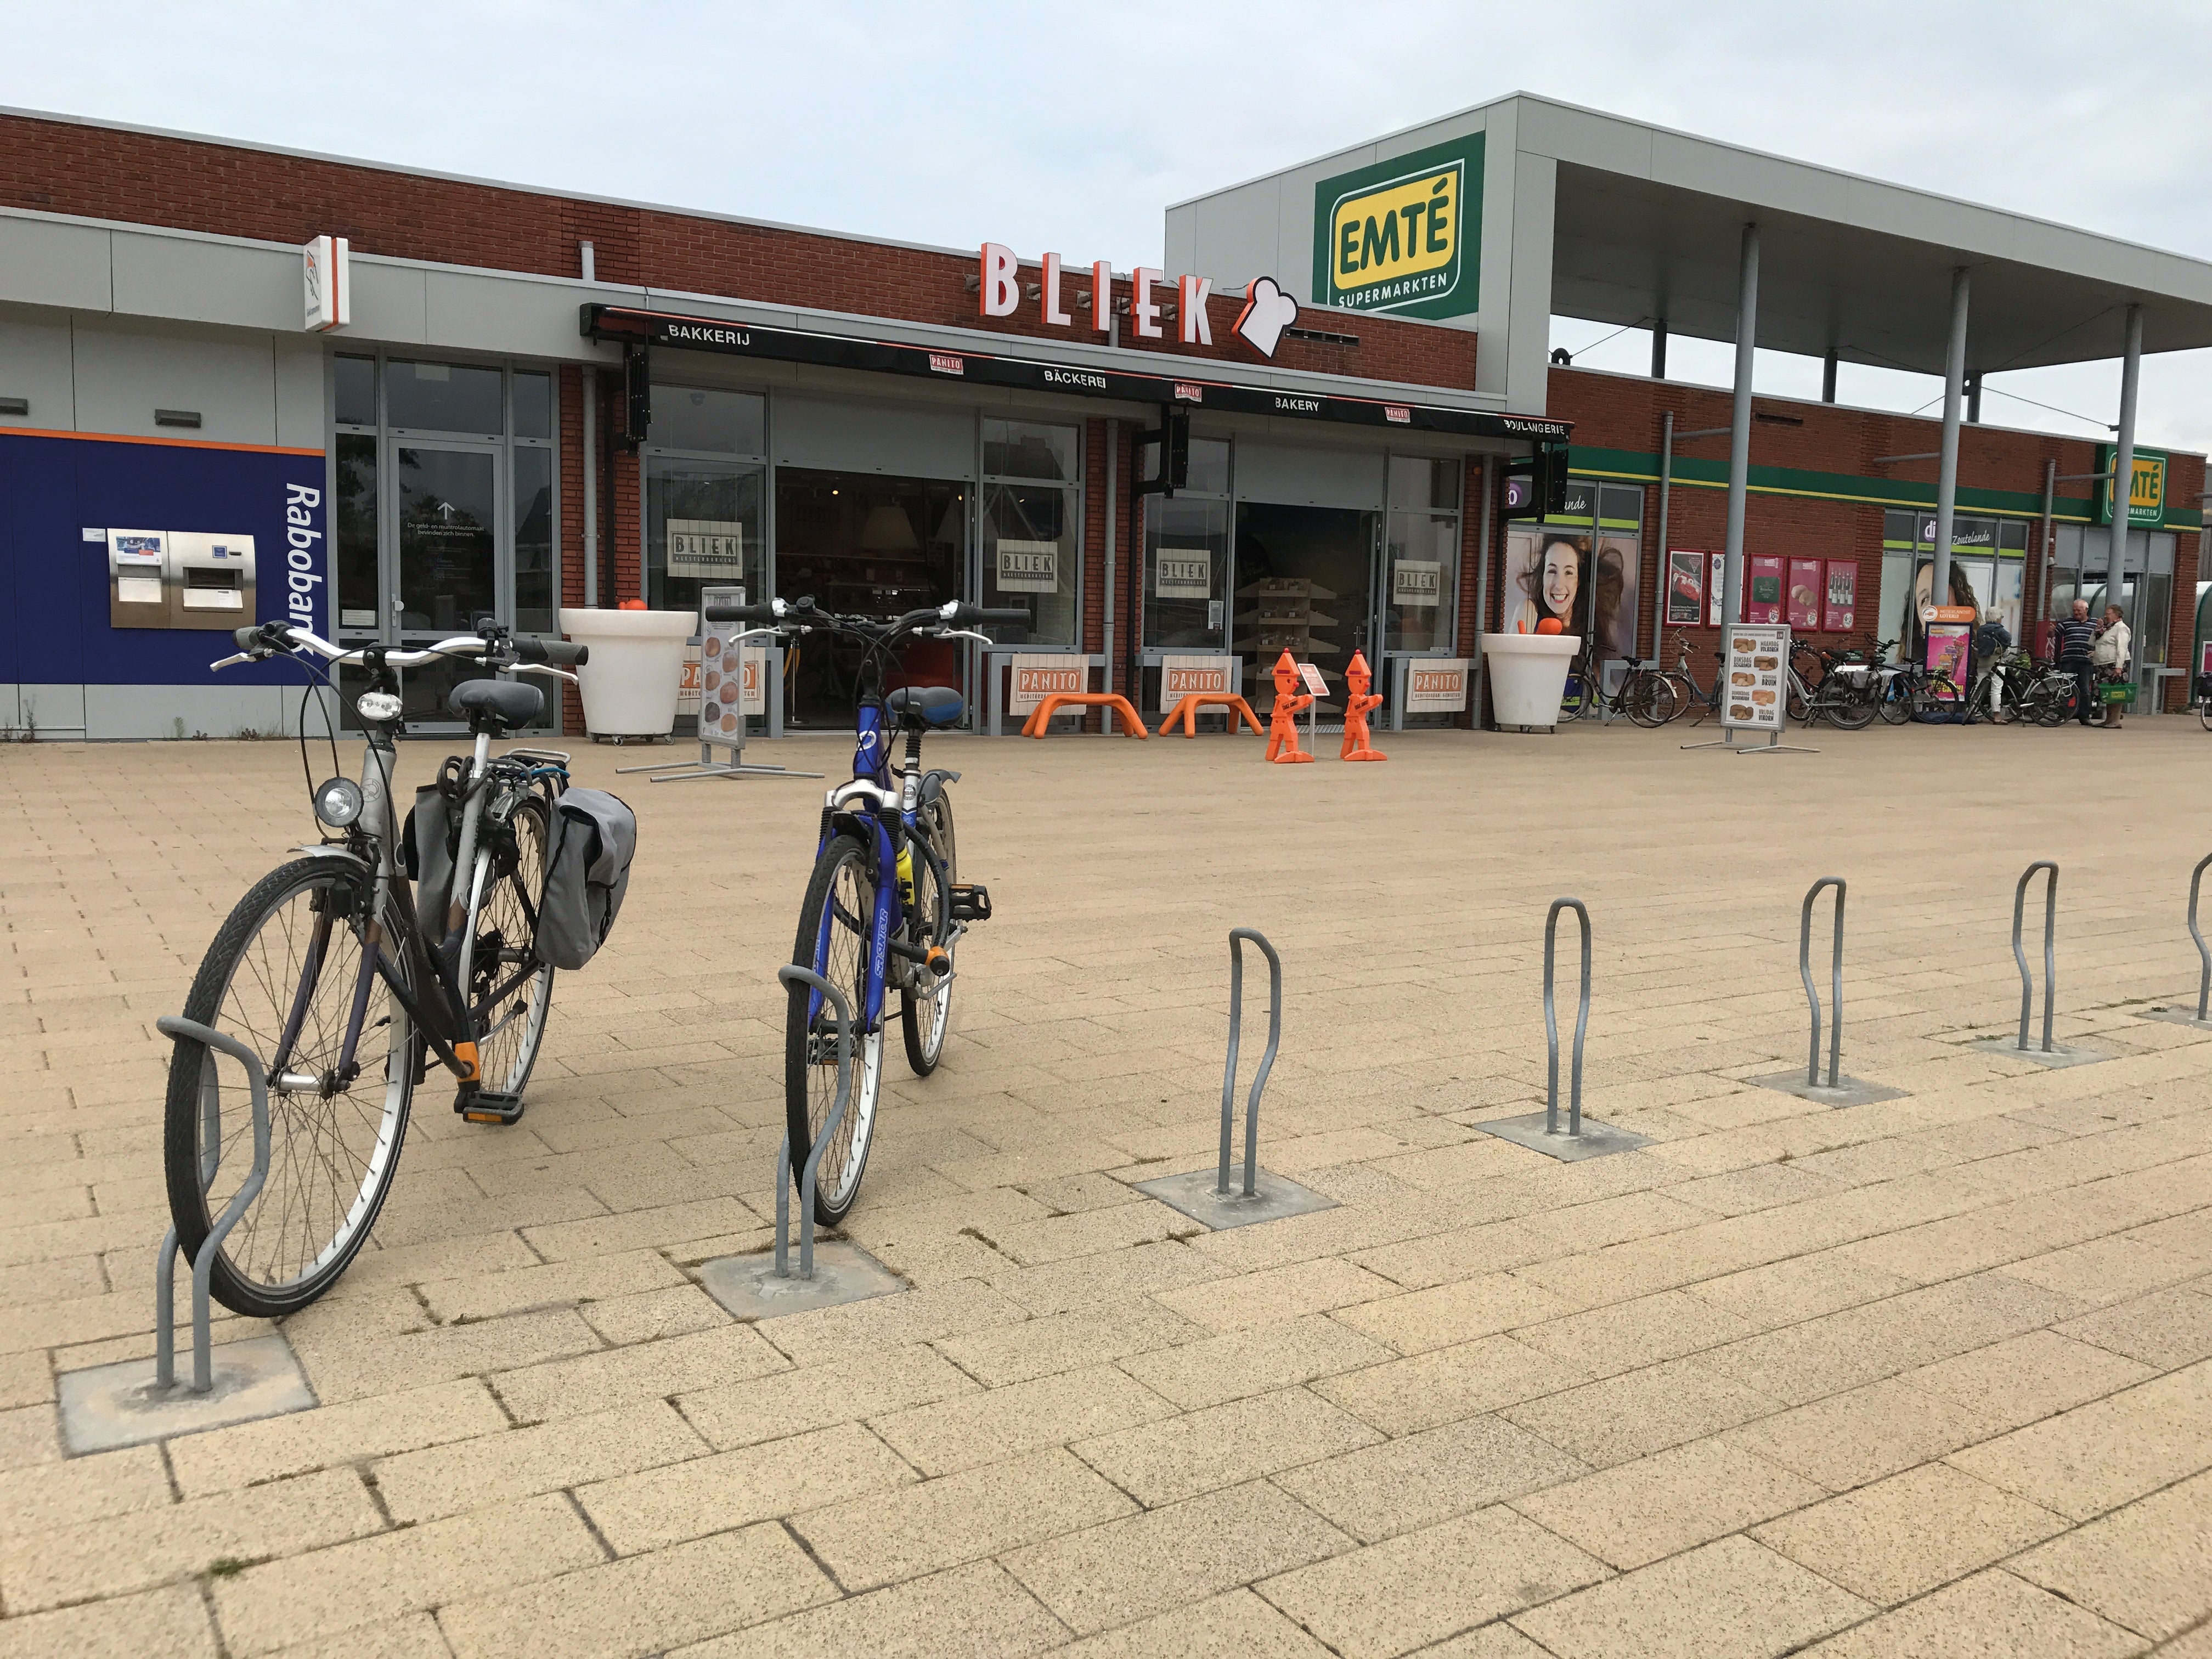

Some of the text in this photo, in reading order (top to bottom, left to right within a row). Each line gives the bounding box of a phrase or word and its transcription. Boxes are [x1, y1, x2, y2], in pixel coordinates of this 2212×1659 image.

[1340, 177, 1449, 274] EMTÉ
[980, 242, 1214, 345] BLIEK
[1339, 273, 1447, 308] SUPERMARKTEN
[668, 324, 750, 346] BAKKERIJ
[932, 357, 960, 369] PANITO
[1044, 369, 1106, 389] BÄCKEREI
[1275, 397, 1319, 412] BAKERY
[1386, 409, 1408, 418] PANITO
[1503, 419, 1565, 435] BOULANGERIE
[2130, 464, 2160, 499] MTÉ
[1925, 520, 1937, 538] di
[1952, 529, 1991, 545] Zoutelande
[675, 536, 734, 555] BLIEK
[1003, 555, 1051, 571] BLIEK
[1162, 563, 1205, 578] BLIEK
[1398, 573, 1435, 588] BLIEK
[1022, 672, 1076, 690] PANITO
[1171, 673, 1221, 690] PANITO
[1415, 674, 1459, 690] PANITO
